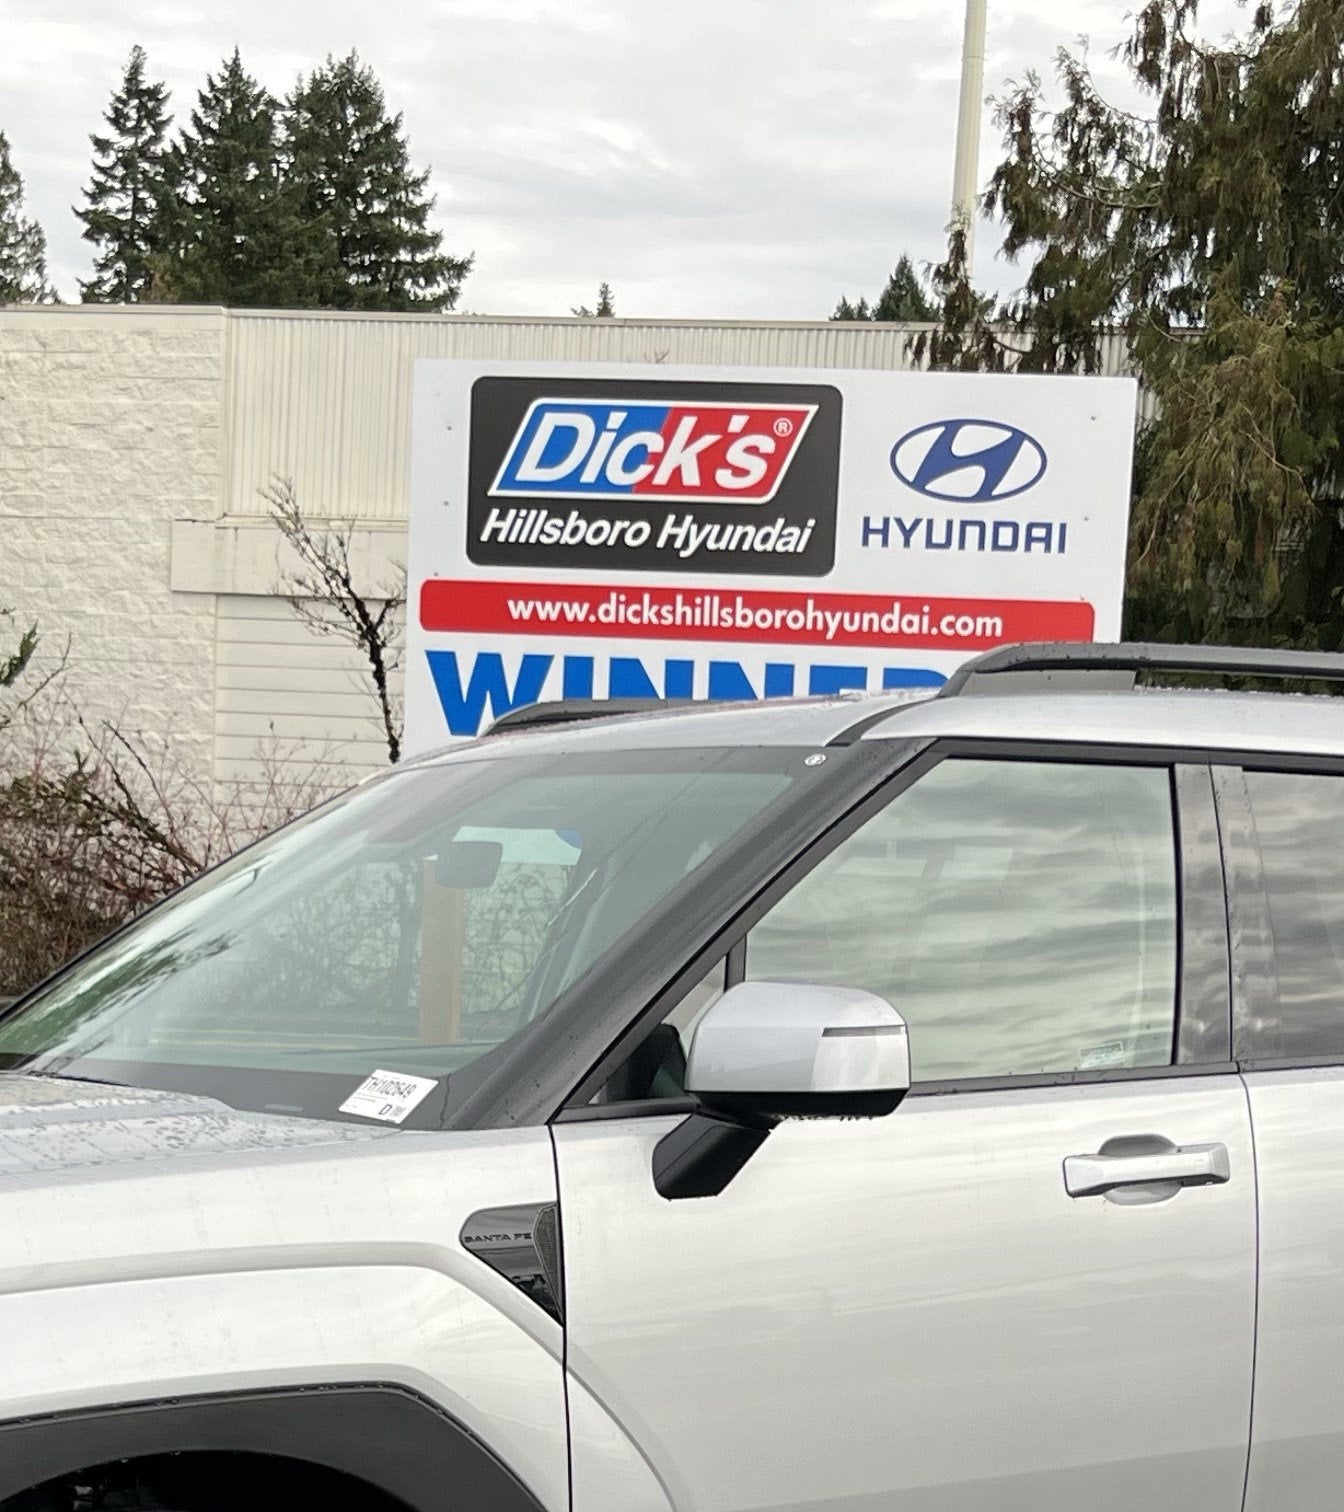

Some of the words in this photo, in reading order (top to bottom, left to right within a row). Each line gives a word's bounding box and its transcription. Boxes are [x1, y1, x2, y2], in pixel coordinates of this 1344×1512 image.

[514, 411, 776, 490] Dick's
[480, 508, 651, 547] Hillsboro
[656, 514, 816, 557] Hyundai
[861, 516, 1067, 554] HYUNDAI
[507, 592, 1003, 640] www.dickshillsborohyundai.com
[464, 1234, 512, 1243] SANTA
[513, 1232, 532, 1240] FE
